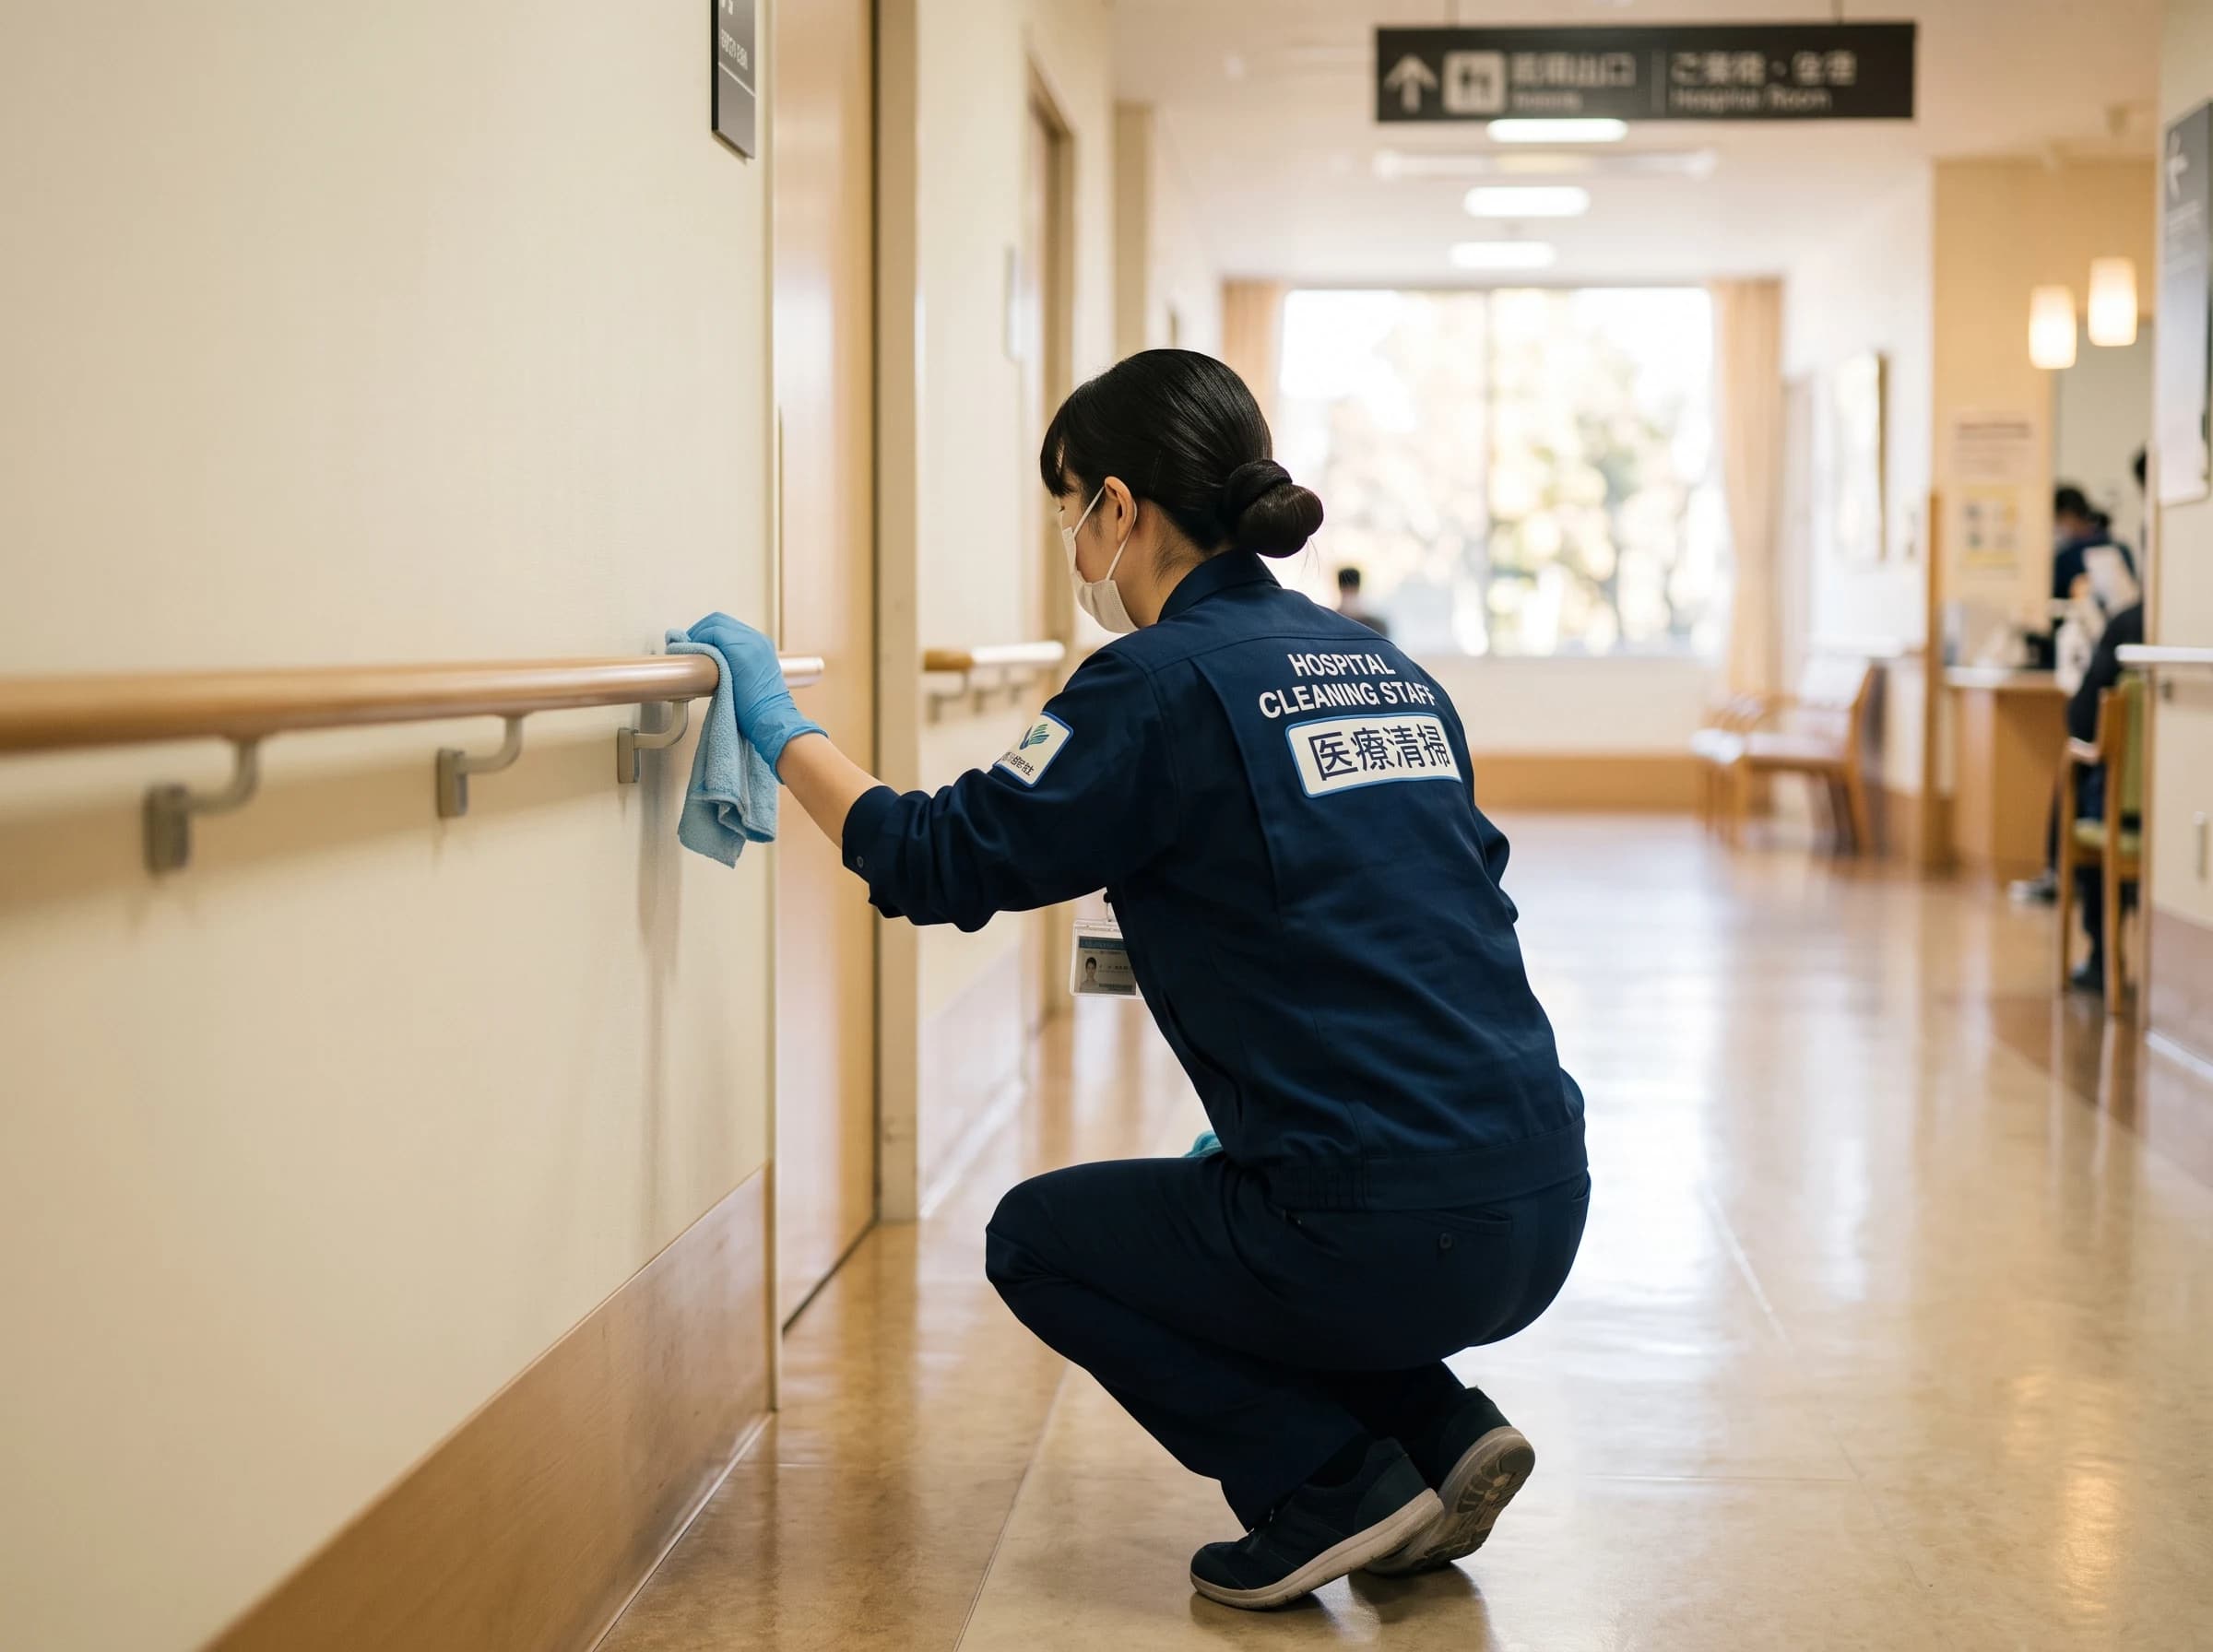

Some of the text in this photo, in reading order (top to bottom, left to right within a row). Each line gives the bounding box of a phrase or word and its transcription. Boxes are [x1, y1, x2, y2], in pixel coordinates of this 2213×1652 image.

[1287, 654, 1396, 677] HOSPITAL
[1259, 681, 1435, 718] CLEANING STAFF
[1308, 724, 1450, 782] 医療清掃
